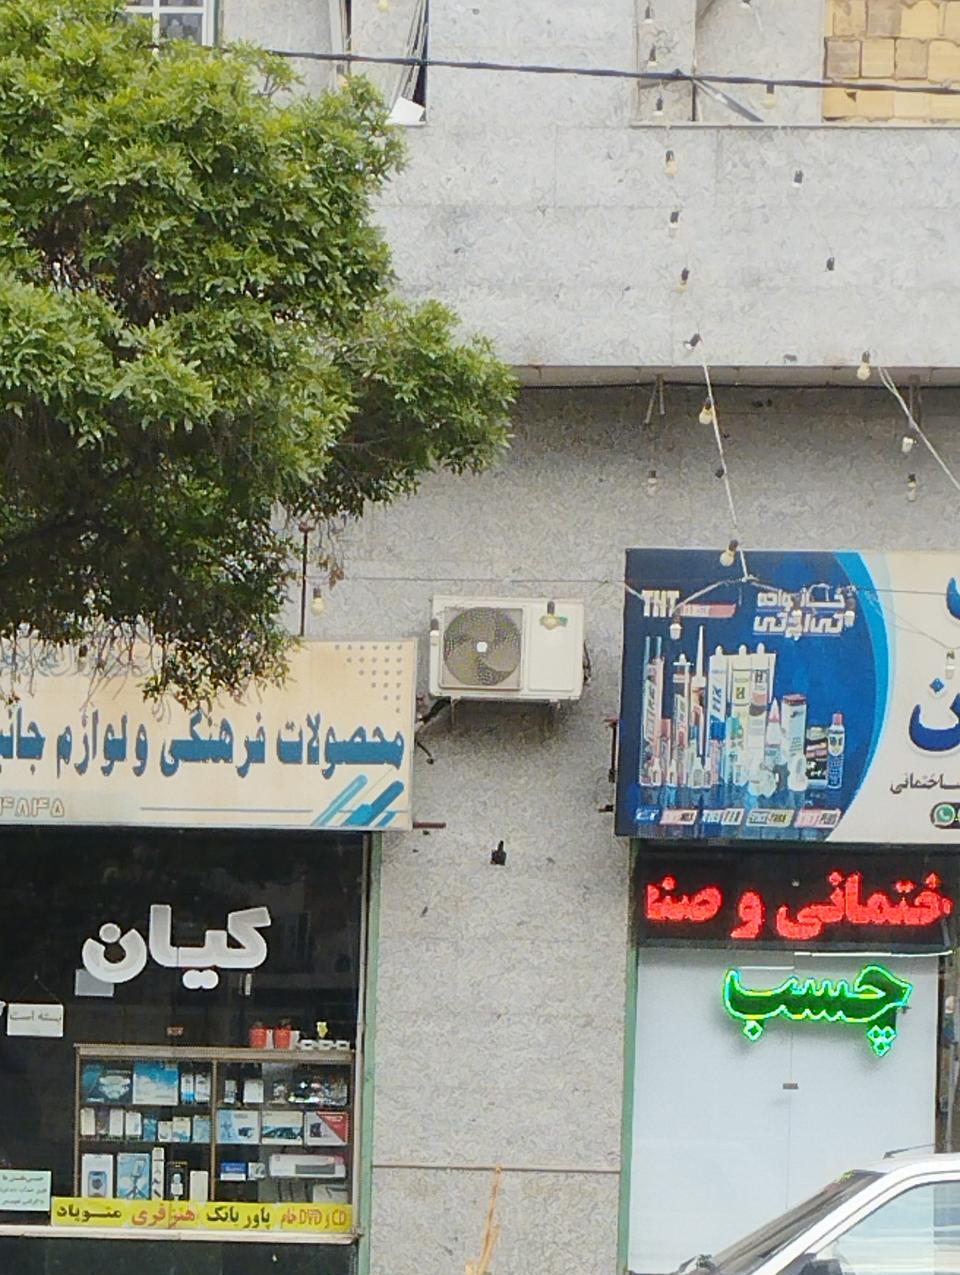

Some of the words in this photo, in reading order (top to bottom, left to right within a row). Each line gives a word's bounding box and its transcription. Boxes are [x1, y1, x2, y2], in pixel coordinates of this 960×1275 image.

[642, 589, 680, 617] THT
[57, 709, 128, 778] لوازم
[160, 709, 266, 778] فرهنگی
[276, 712, 405, 780] محصولات
[82, 904, 272, 990] کیان
[730, 890, 765, 939] و
[723, 965, 913, 1058] چسب
[206, 1205, 240, 1226] بانک
[243, 1206, 271, 1230] پاور
